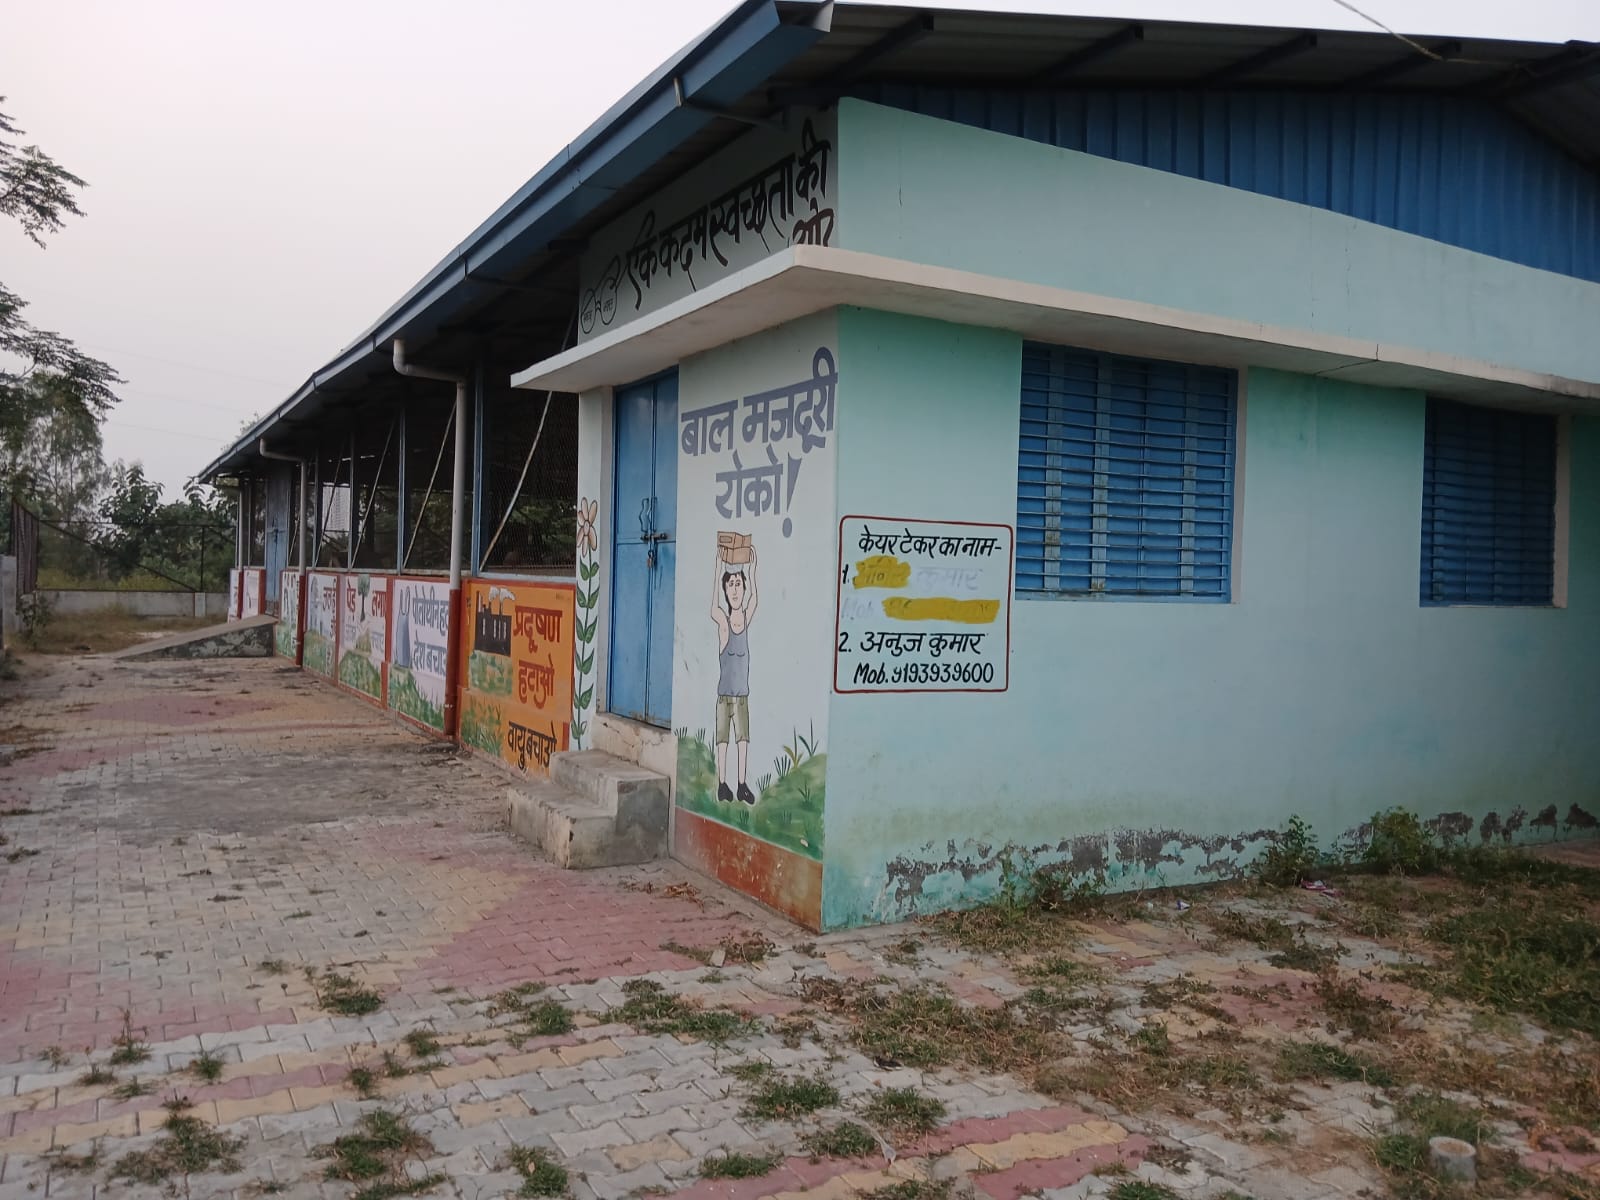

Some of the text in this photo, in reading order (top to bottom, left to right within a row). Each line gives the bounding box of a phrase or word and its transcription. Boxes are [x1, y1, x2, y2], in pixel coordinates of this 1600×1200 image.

[795, 116, 832, 202] की
[681, 346, 838, 456] बाल मजदूरी
[939, 537, 963, 557] का
[513, 605, 563, 652] प्रदूषण
[838, 631, 985, 657] 2. अनुज कुमार
[518, 653, 555, 709] हटाओ
